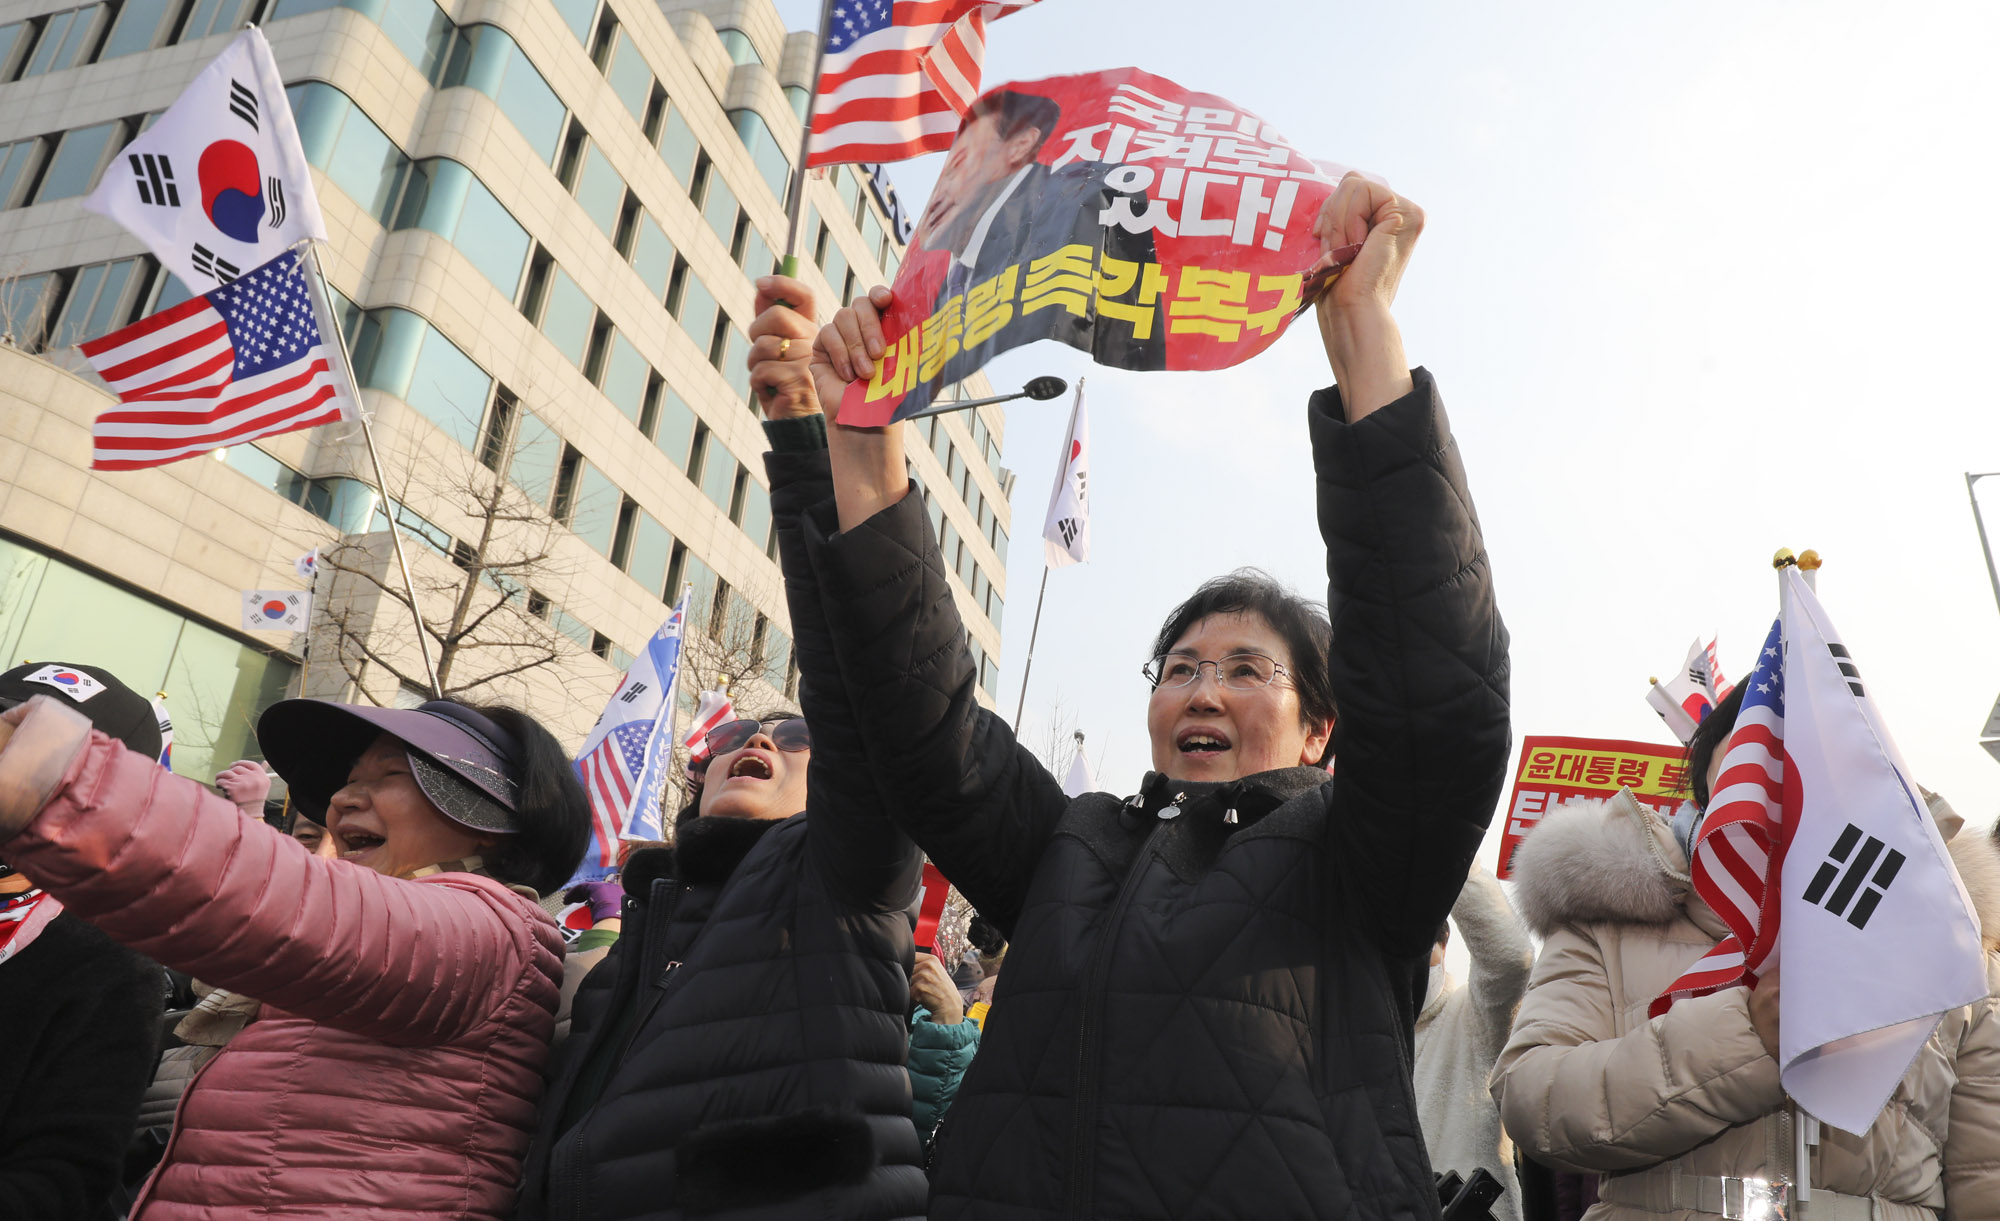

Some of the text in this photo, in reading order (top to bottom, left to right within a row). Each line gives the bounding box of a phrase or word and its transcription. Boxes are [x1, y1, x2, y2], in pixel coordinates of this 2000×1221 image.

[1098, 165, 1300, 252] 있다!
[864, 264, 1020, 403] 대통령
[1020, 243, 1169, 340] 즉각
[1527, 751, 1650, 788] 윤대통령
